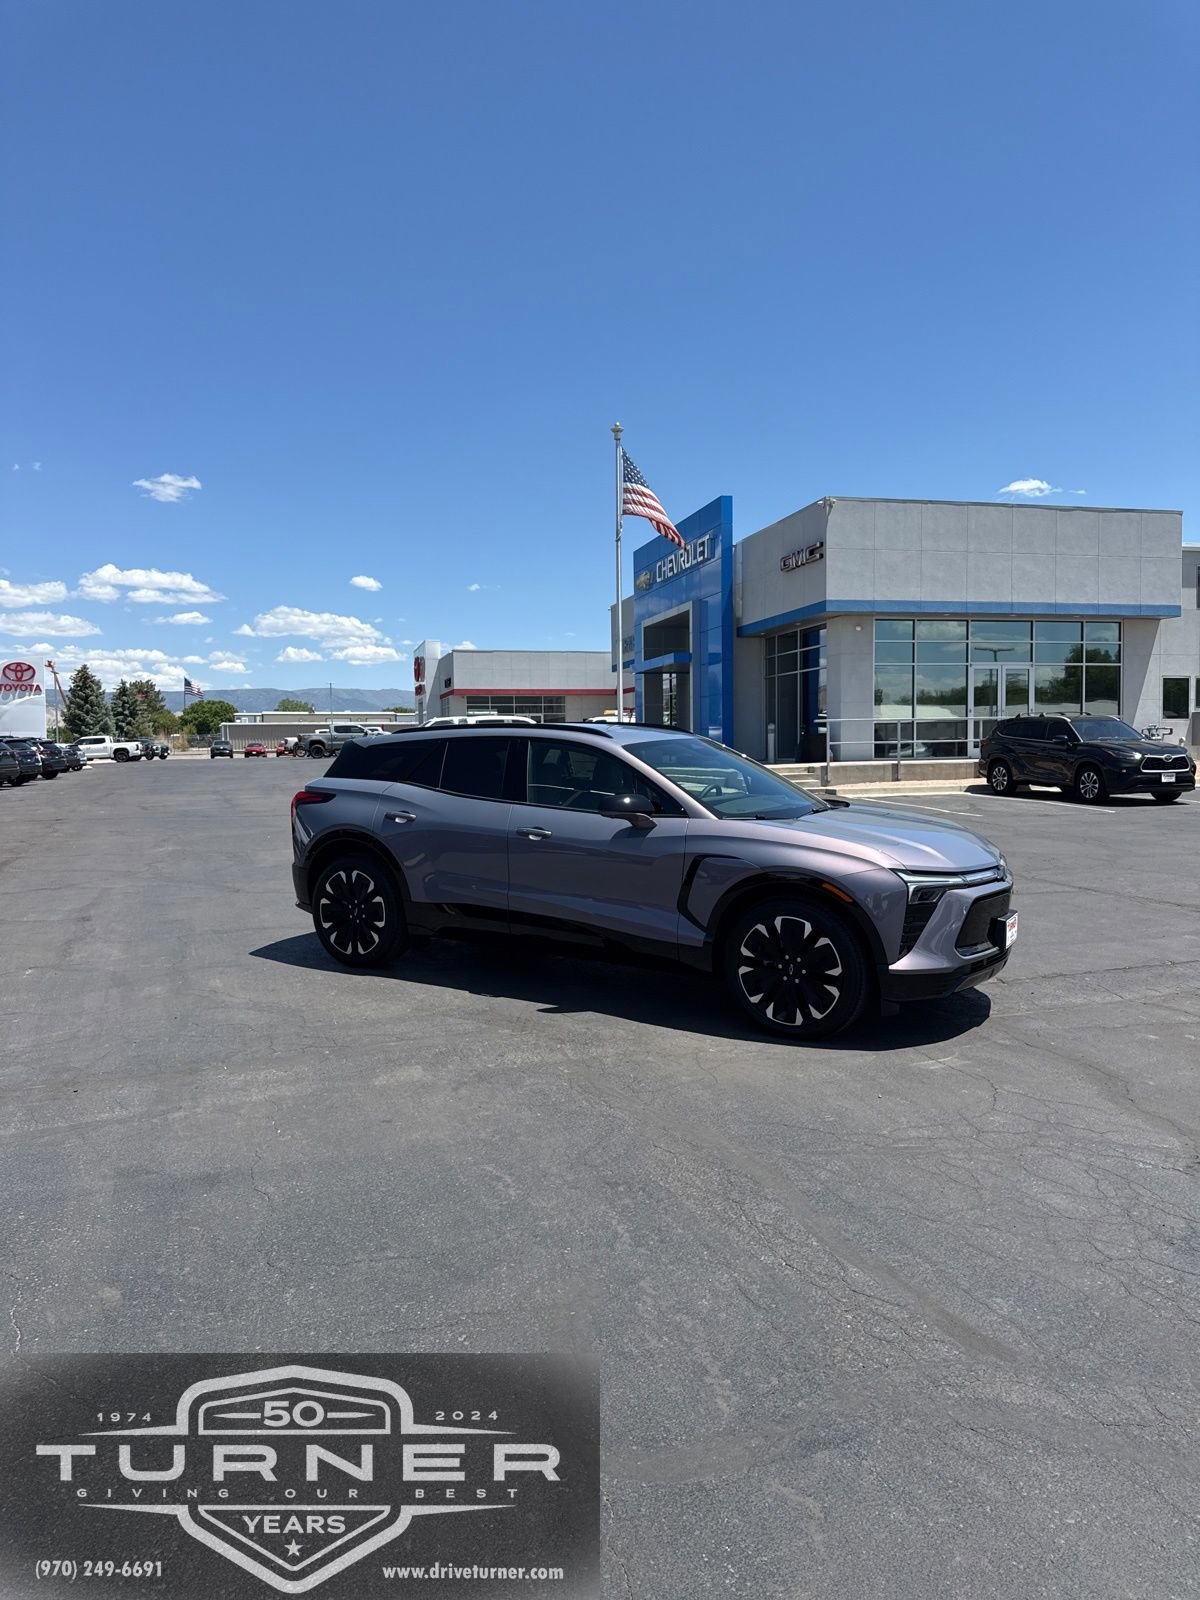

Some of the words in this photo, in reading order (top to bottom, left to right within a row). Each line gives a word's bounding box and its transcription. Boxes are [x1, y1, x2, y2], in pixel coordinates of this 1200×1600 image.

[656, 534, 710, 583] CHEVROLET
[780, 541, 824, 572] GMC
[0, 683, 42, 692] TOYOTA
